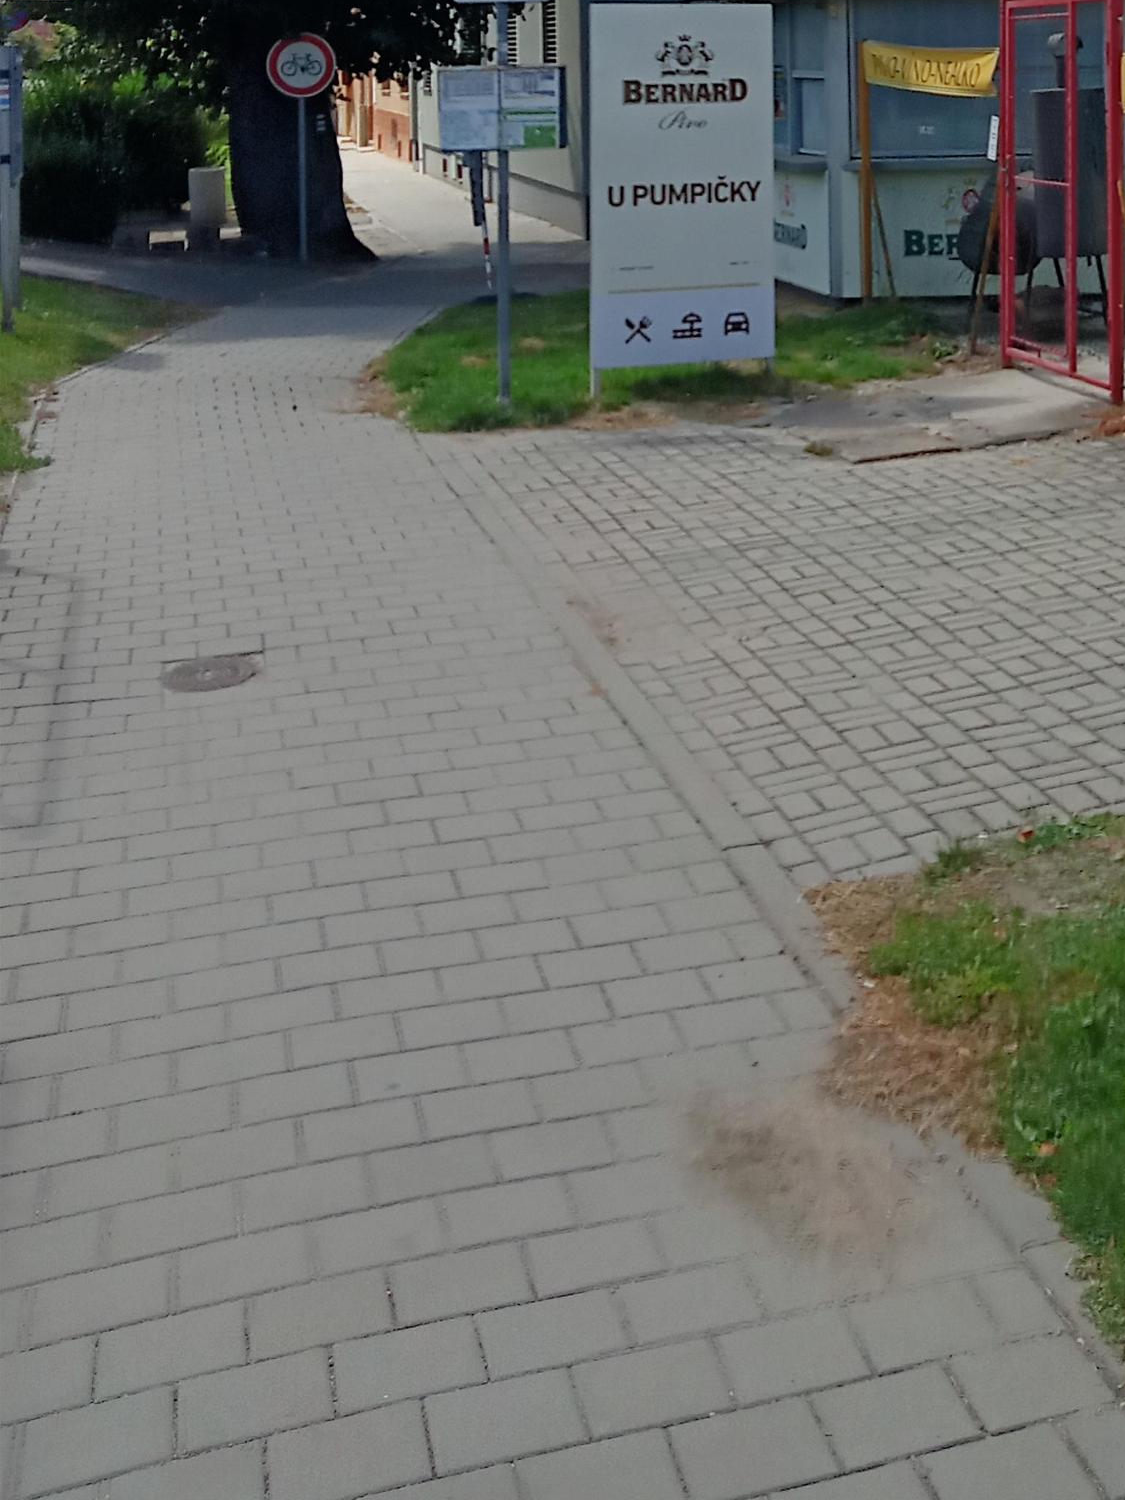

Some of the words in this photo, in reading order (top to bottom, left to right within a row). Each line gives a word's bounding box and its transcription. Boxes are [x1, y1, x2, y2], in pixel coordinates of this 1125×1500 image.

[622, 77, 748, 105] BERNARD
[657, 110, 708, 131] Pivo
[608, 185, 625, 207] U
[633, 175, 761, 206] PUMPIČKY
